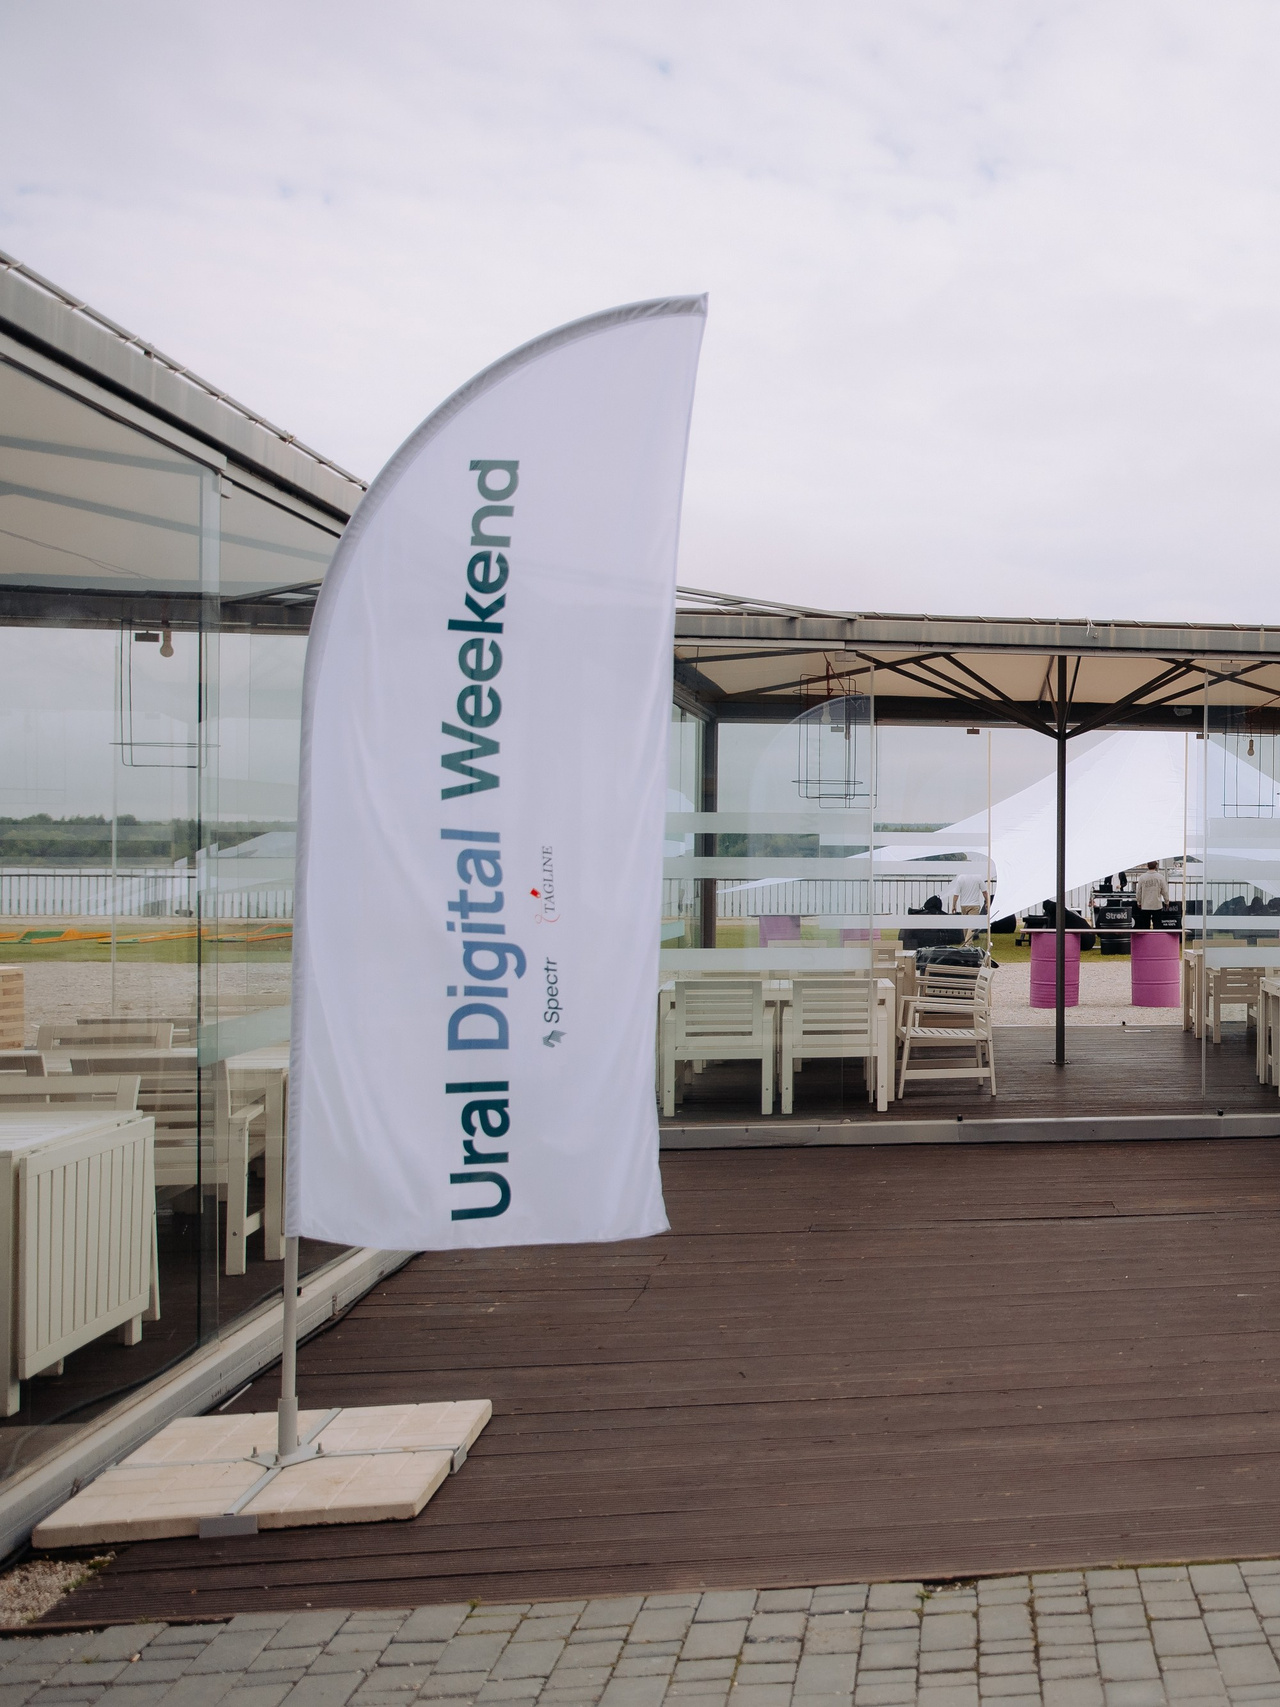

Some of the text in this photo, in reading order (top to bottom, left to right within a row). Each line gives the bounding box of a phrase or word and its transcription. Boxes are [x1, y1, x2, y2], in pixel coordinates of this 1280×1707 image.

[440, 459, 527, 1221] Ural Digital Weekend
[542, 845, 555, 914] TAGLINE
[1105, 911, 1128, 920] Stroki
[543, 957, 563, 1024] Spectr
